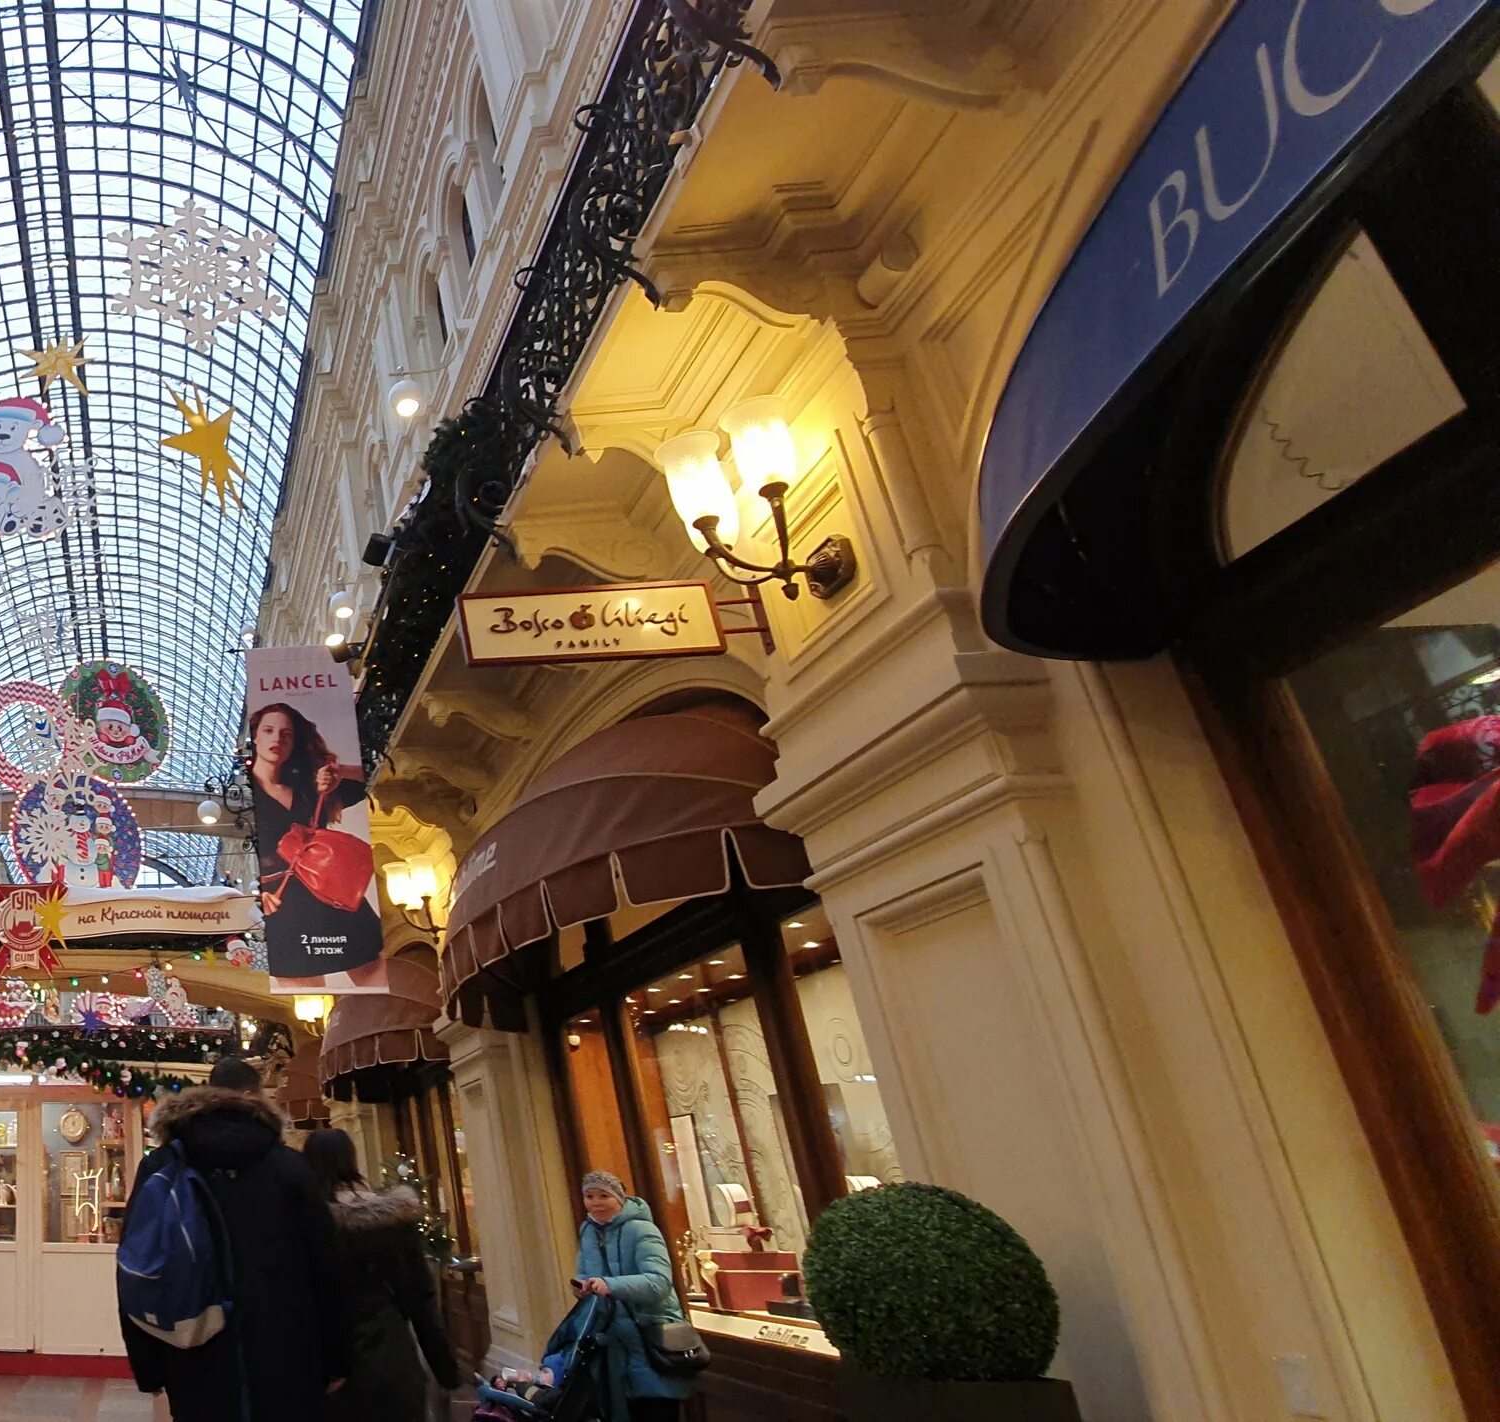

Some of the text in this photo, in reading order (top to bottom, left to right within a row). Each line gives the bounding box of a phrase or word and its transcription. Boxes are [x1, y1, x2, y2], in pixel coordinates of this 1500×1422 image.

[1148, 0, 1437, 299] BUC
[555, 638, 621, 649] FAMILY
[259, 674, 338, 691] LANCEL
[11, 890, 38, 910] ГУМ
[77, 914, 97, 924] на
[100, 906, 163, 925] Красной
[166, 909, 231, 924] площади
[300, 934, 347, 944] 2 линия
[14, 953, 35, 962] GUM
[305, 946, 344, 955] 1 этаж
[754, 1325, 810, 1349] Sublime
